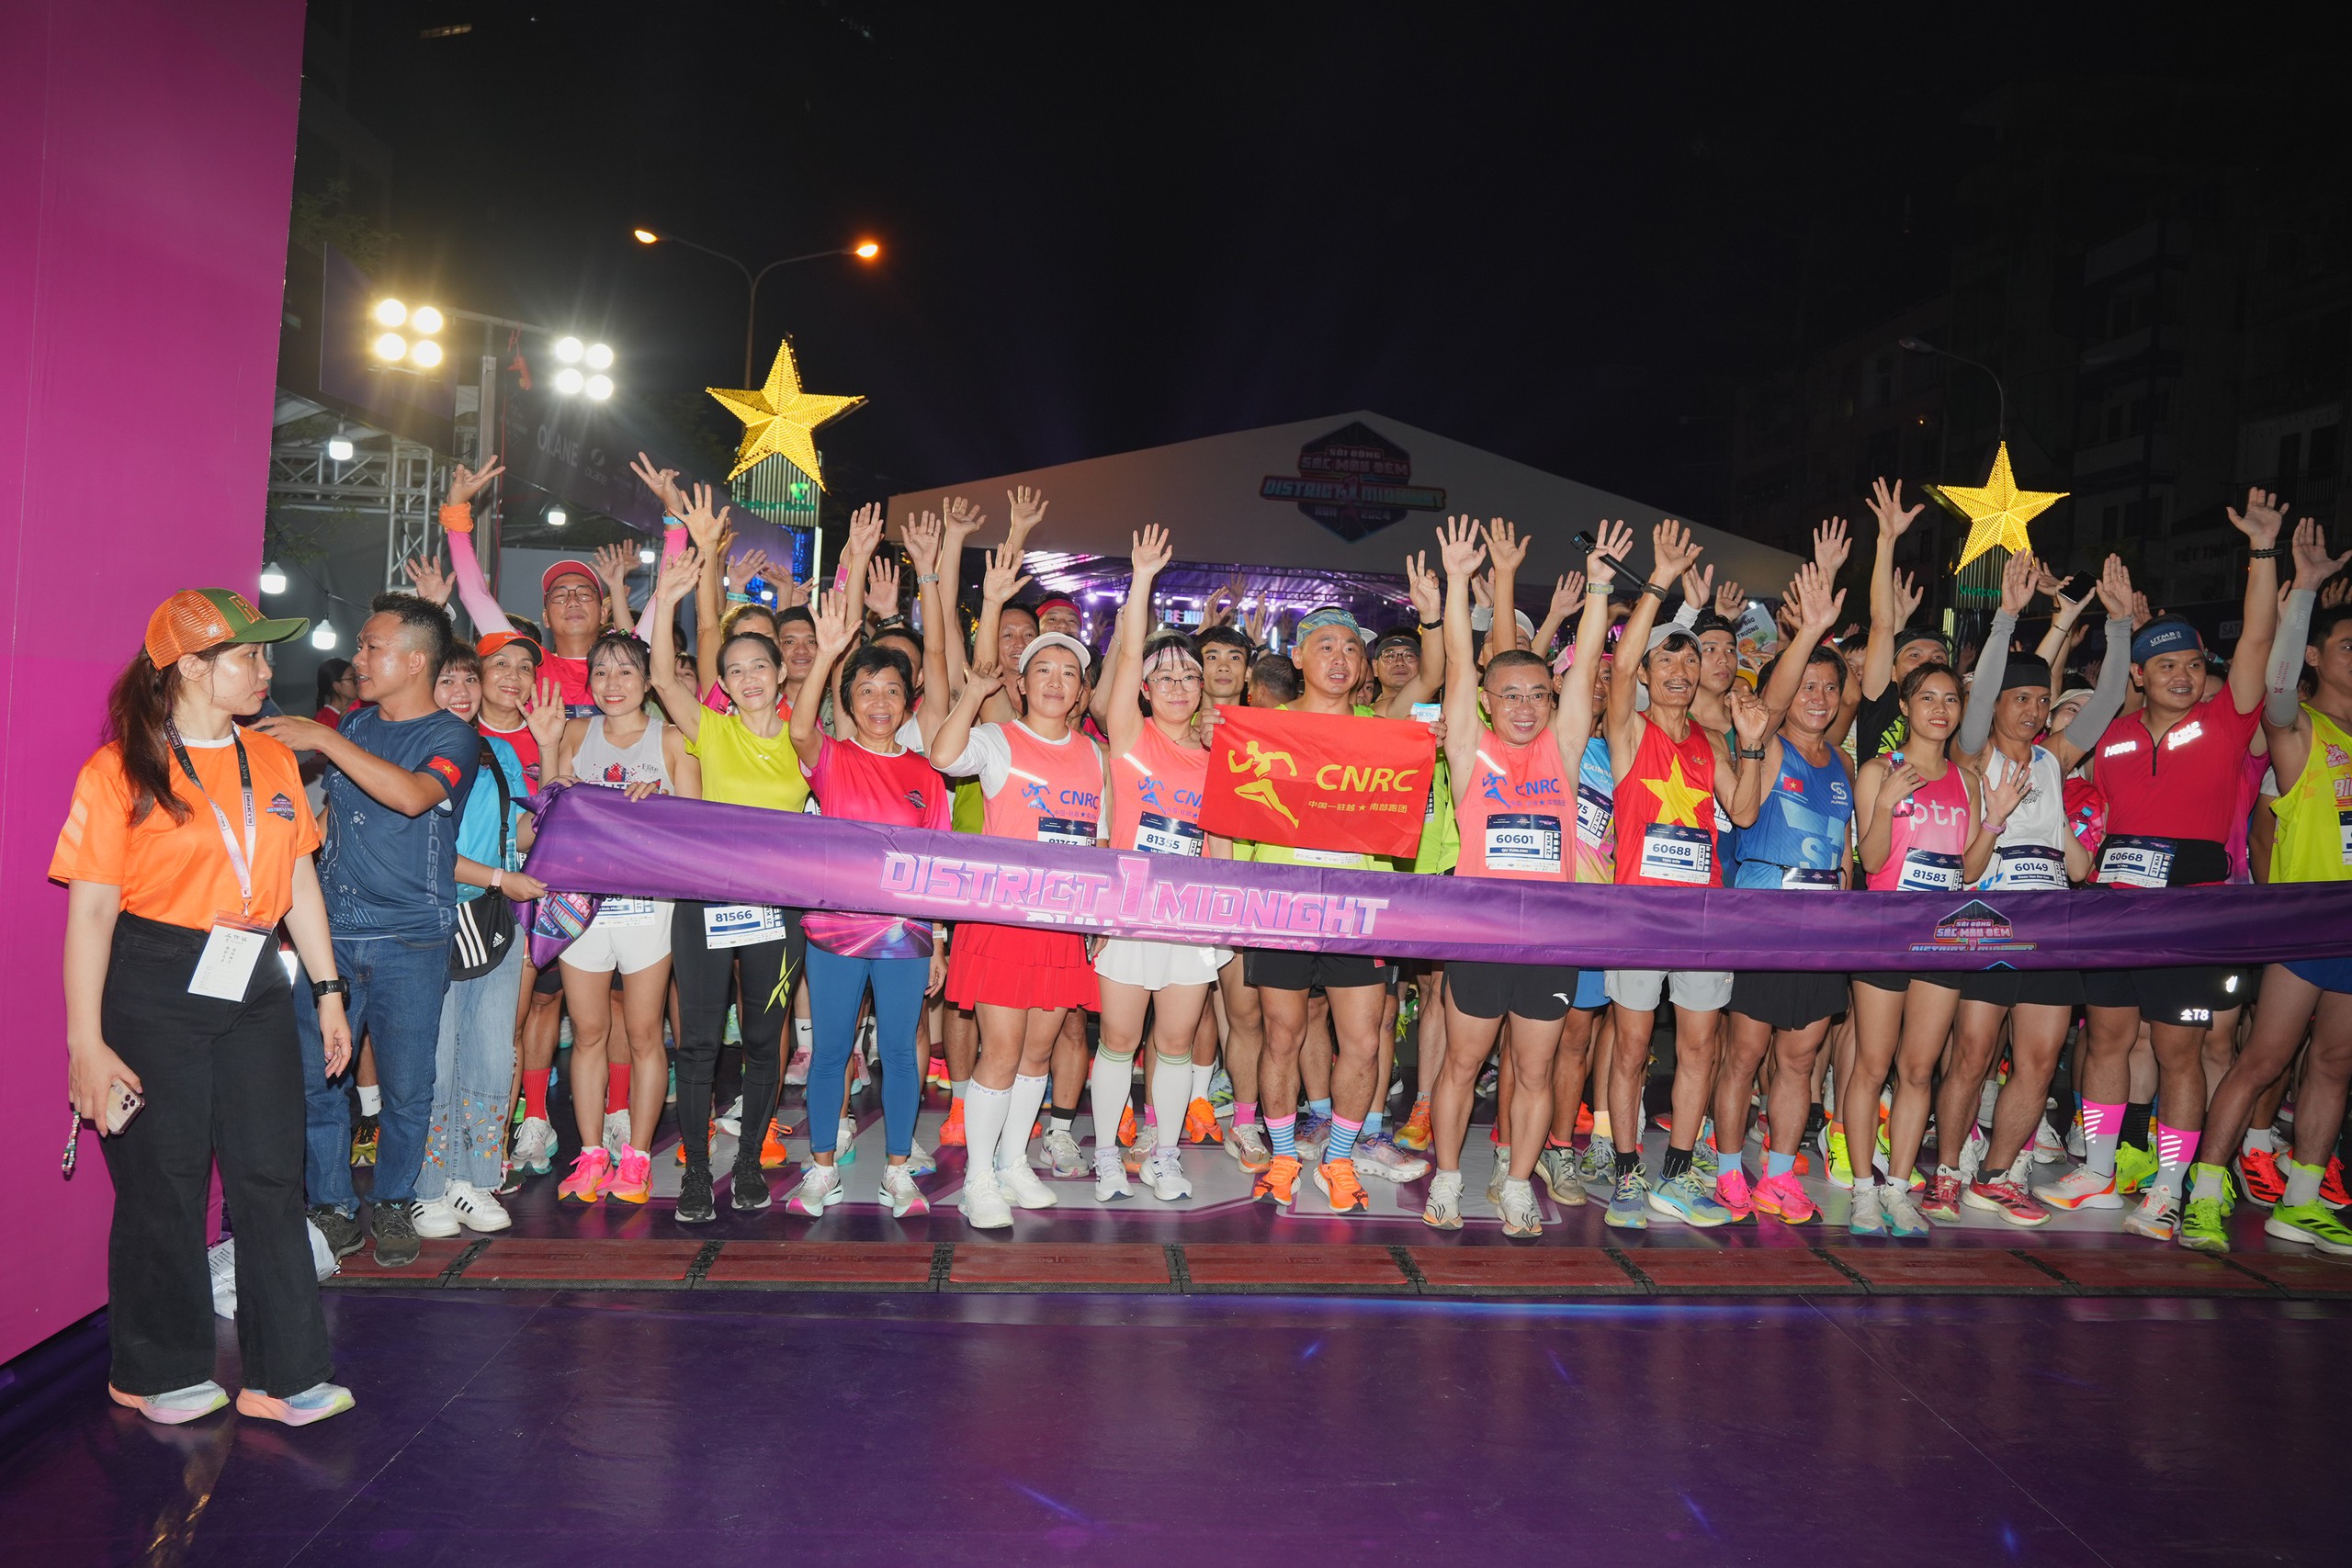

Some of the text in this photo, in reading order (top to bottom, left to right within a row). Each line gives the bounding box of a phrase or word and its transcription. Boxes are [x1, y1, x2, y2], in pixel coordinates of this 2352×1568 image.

[1263, 479, 1342, 497] DISTRICT
[2150, 631, 2176, 644] UTMB
[642, 763, 659, 773] Elite
[1316, 764, 1419, 792] CNRC
[1515, 778, 1560, 797] CNRC
[1059, 790, 1100, 810] CNRC
[1174, 789, 1203, 808] CN
[1909, 799, 1966, 831] ptr
[1146, 833, 1181, 850] 81355
[1496, 834, 1534, 844] 60601
[1653, 843, 1690, 856] 60688
[2109, 852, 2143, 862] 60668
[2015, 863, 2049, 872] 60149
[1913, 869, 1947, 883] 81583
[878, 851, 1391, 935] DISTRICT 1 MIDNIGHT
[715, 909, 752, 922] 81566
[971, 1083, 997, 1096] LOVE
